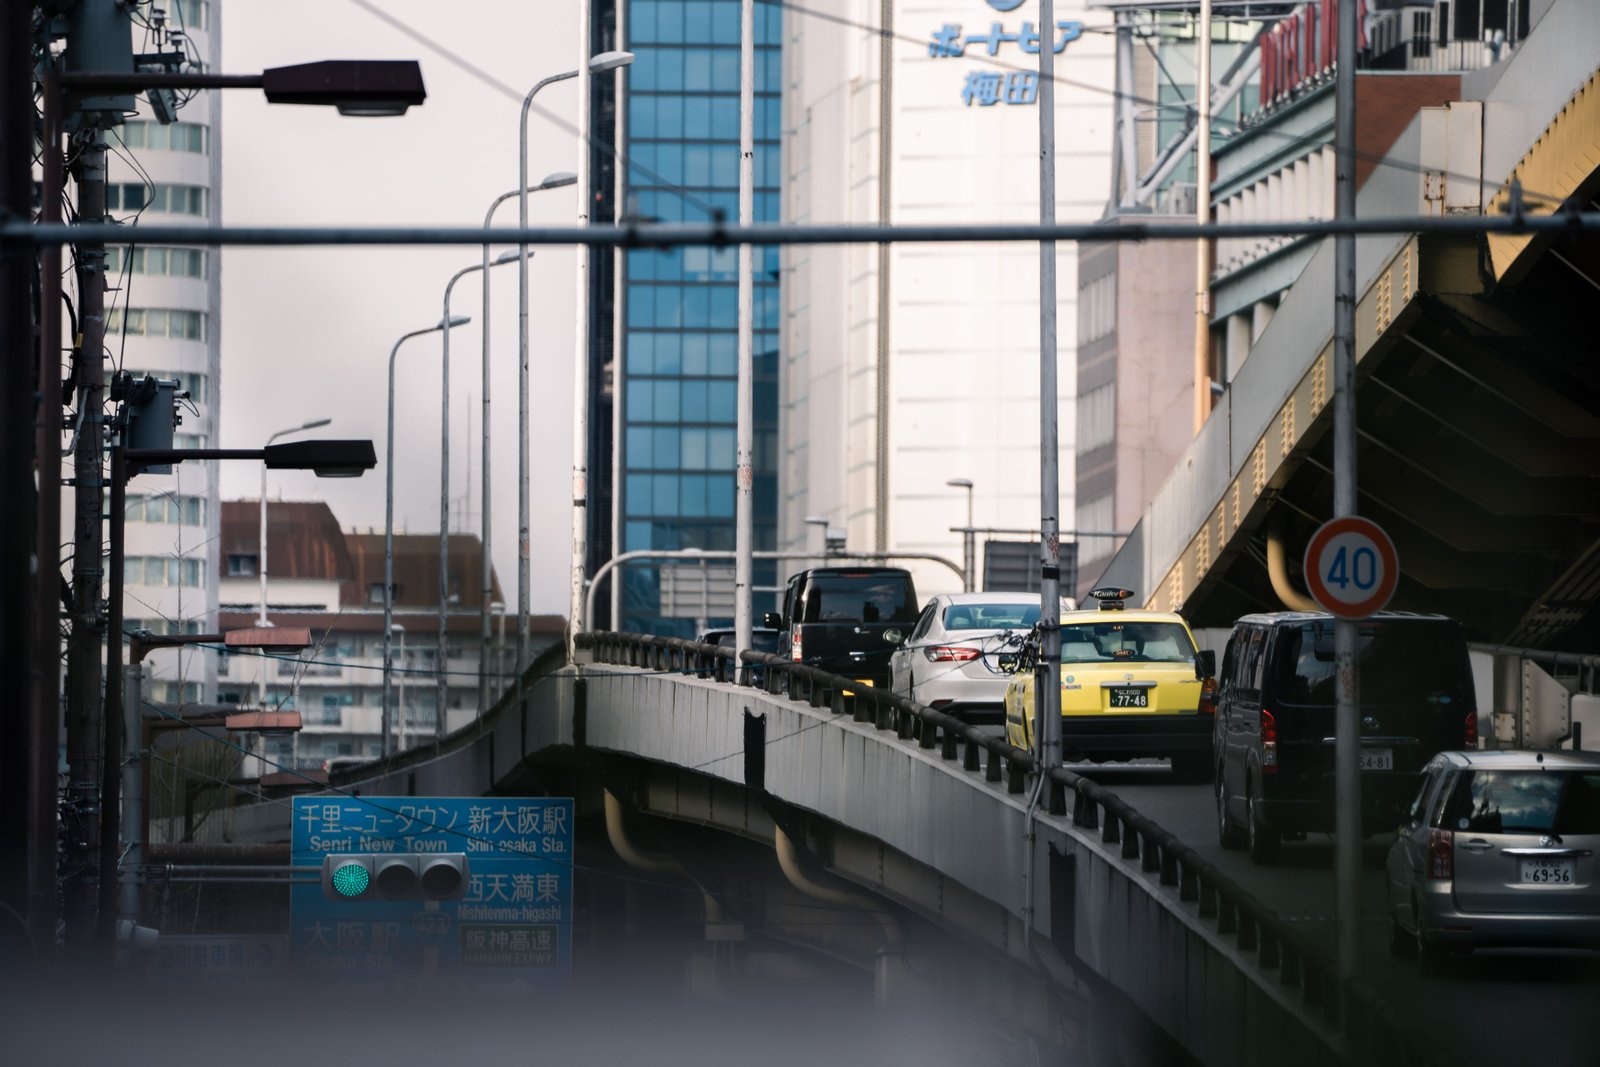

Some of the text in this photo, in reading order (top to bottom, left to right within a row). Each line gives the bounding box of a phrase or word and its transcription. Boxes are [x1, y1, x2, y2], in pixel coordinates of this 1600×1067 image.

[962, 71, 1040, 107] 梅田
[1327, 545, 1377, 591] 40
[1118, 695, 1147, 707] 77-48
[299, 804, 568, 835] 千里ニュータウン 新大阪駅
[309, 835, 448, 852] Senri New Town
[542, 837, 568, 853] Sta.
[462, 873, 561, 902] 西天満東
[1532, 868, 1571, 882] 69-56
[304, 920, 552, 952] 大阪駅 阪神高速
